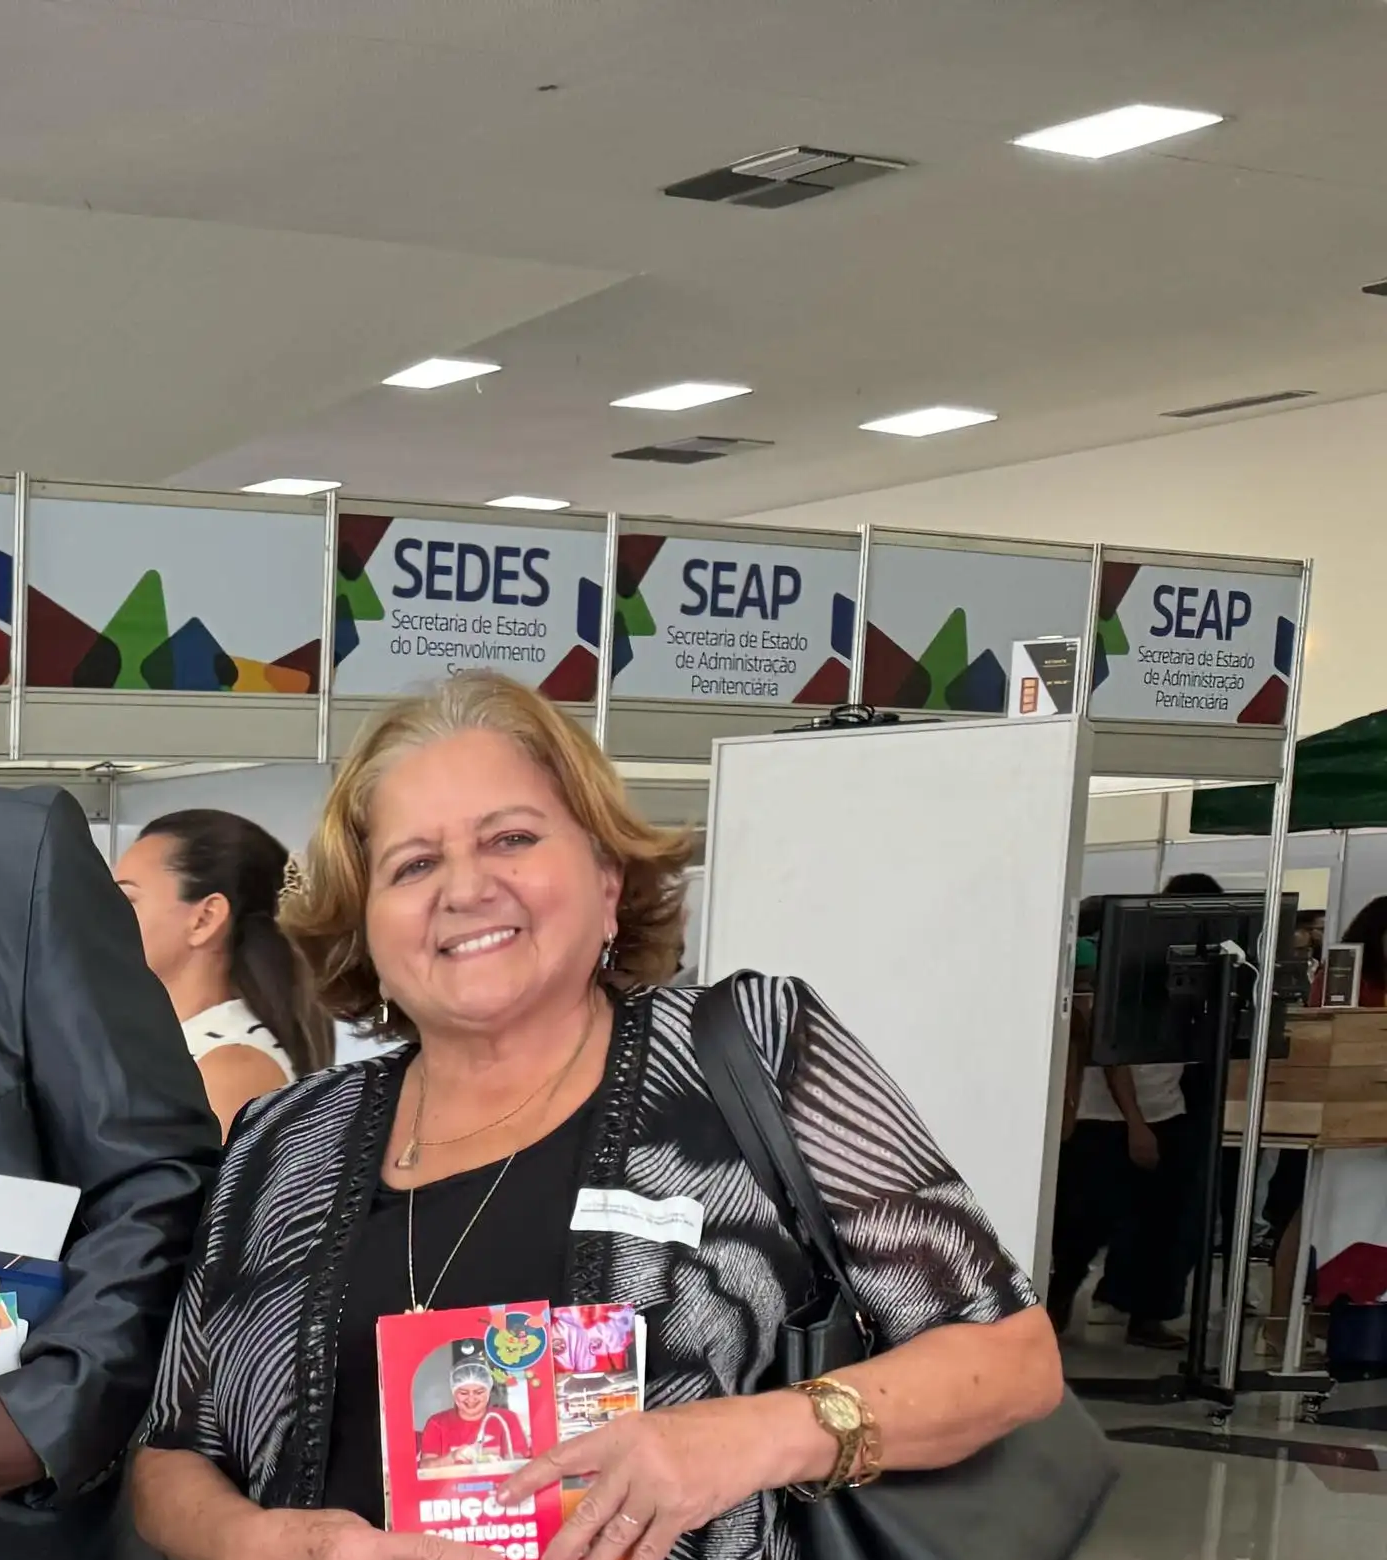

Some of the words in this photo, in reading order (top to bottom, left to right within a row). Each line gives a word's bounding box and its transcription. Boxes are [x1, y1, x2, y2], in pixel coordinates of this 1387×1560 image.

[392, 537, 551, 607] SEDES
[680, 558, 802, 621] SEAP
[391, 609, 467, 633] Secretaria
[472, 615, 492, 634] de
[496, 615, 547, 638] Estado
[1149, 584, 1252, 641] SEAP
[390, 635, 412, 655] do
[416, 636, 546, 663] Desenvolvimento
[667, 625, 735, 648] Secretaria
[739, 630, 758, 648] de
[762, 630, 808, 651] Estado
[675, 650, 695, 669] de
[698, 651, 797, 676] Administração
[1138, 645, 1194, 665] Secretaria
[1197, 649, 1213, 667] de
[1216, 650, 1255, 669] Estado
[691, 674, 779, 697] Penitenciária
[1143, 668, 1160, 685] de
[1162, 669, 1245, 692] Administração
[1155, 690, 1229, 710] Penitenciária
